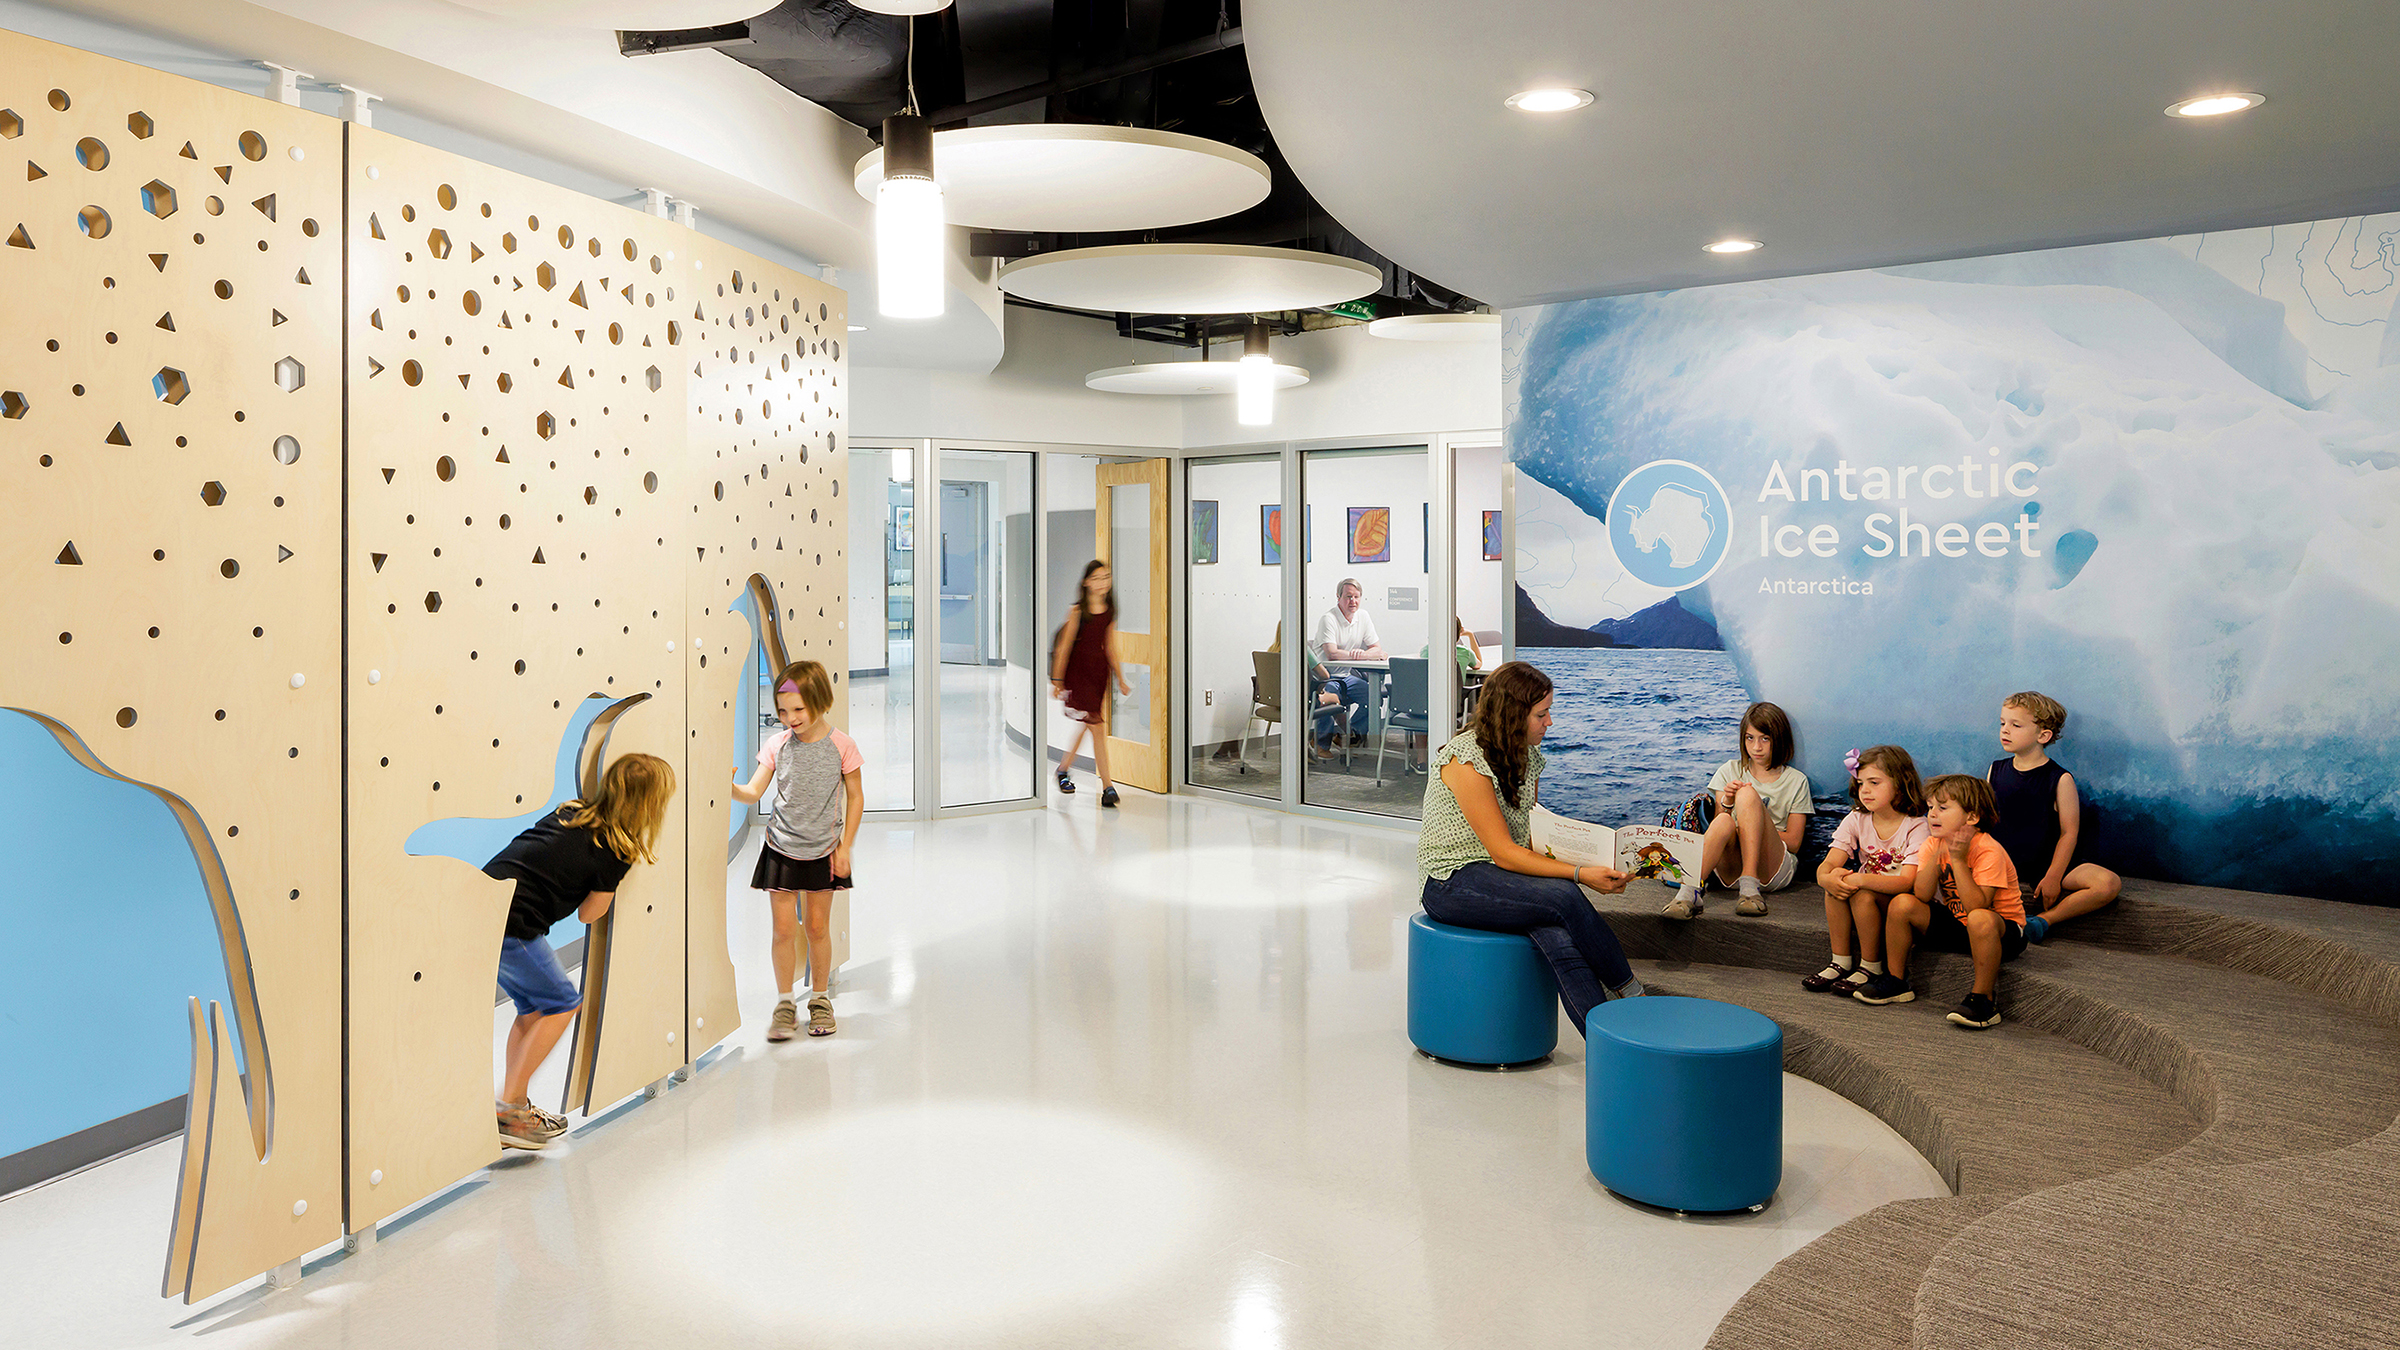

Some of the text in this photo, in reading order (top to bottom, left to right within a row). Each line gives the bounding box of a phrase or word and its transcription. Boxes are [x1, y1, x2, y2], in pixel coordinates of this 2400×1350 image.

[1757, 446, 2040, 502] Antarctic
[1760, 507, 2041, 558] Ice Sheet
[1758, 576, 1874, 596] Antarctica
[1635, 827, 1681, 841] Perfect
